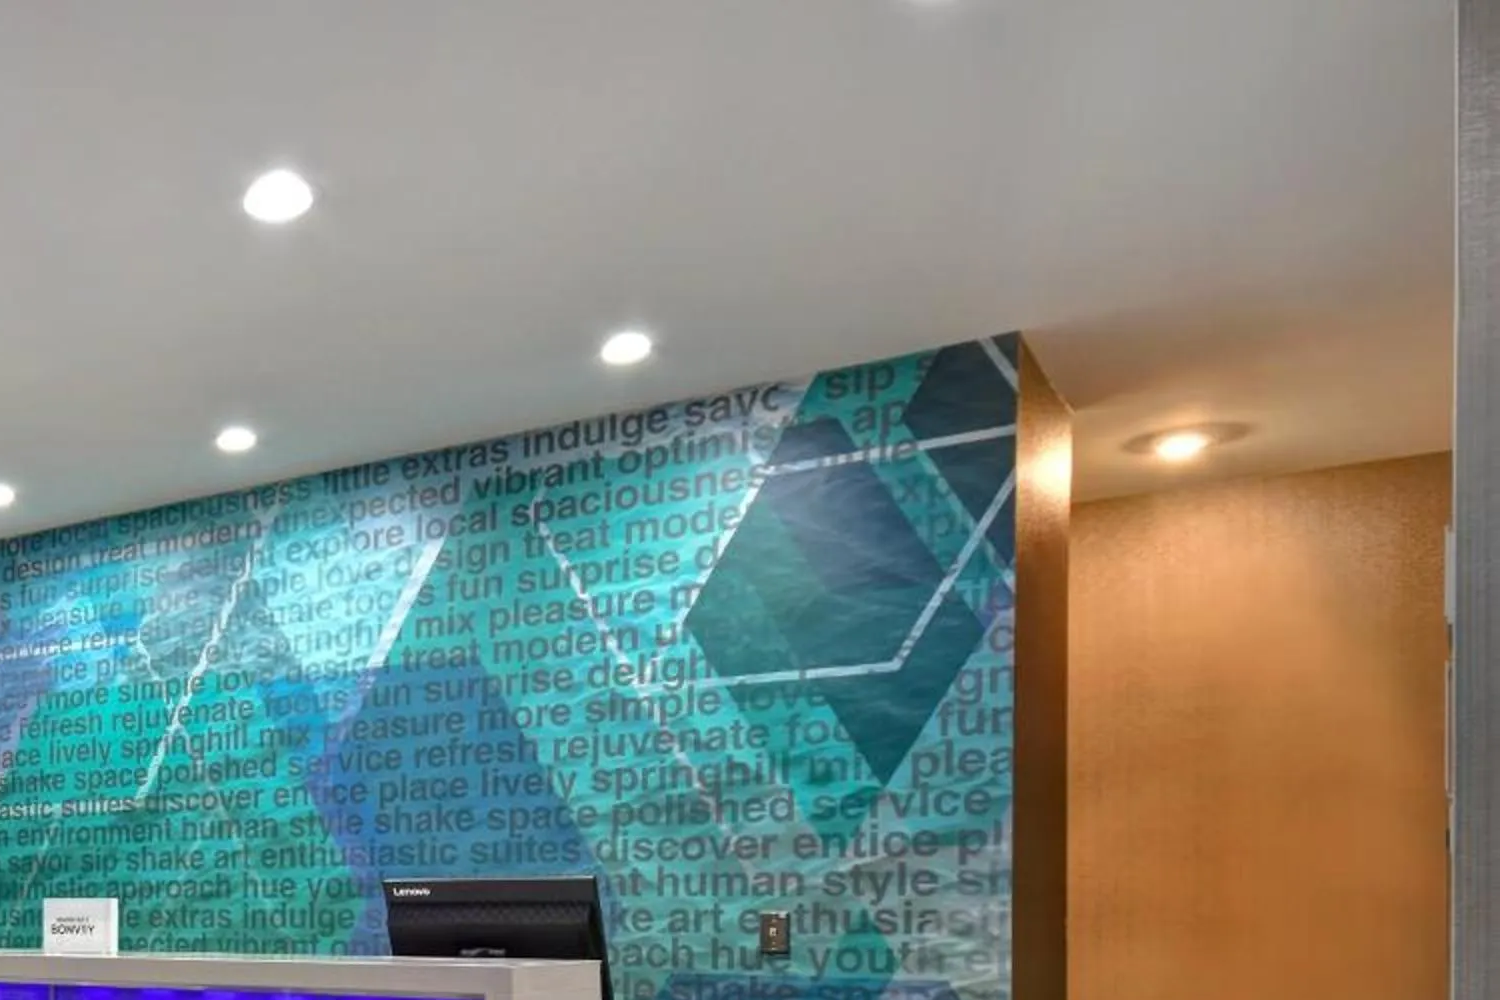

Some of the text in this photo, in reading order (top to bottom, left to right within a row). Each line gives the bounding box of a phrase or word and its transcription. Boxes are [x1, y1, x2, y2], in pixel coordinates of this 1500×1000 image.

[118, 480, 309, 538] spaciousness
[323, 464, 388, 495] little
[403, 441, 508, 481] extras
[524, 409, 668, 458] indulge
[685, 387, 778, 427] savo
[825, 364, 894, 401] sip
[3, 553, 79, 582] design
[92, 537, 146, 567] treat
[157, 519, 261, 556] modern
[275, 477, 459, 535] unexpected
[474, 452, 604, 500] vibrant
[619, 423, 777, 477] optimis
[20, 585, 56, 607] fun
[66, 566, 167, 599] surprise
[286, 525, 404, 564] explore
[417, 504, 496, 542] local
[511, 463, 767, 530] spaciousnes
[21, 600, 121, 637] pleasure
[134, 588, 198, 615] more
[318, 560, 383, 588] love
[395, 541, 510, 577] dsign
[523, 521, 609, 559] treat
[627, 503, 737, 544] mode
[345, 586, 433, 617] focs
[447, 576, 502, 603] fun
[517, 551, 678, 594] surprise
[416, 610, 474, 640] mix
[489, 590, 654, 638] pleasure
[20, 711, 101, 740] refresh
[113, 699, 253, 735] rejuvenate
[266, 691, 348, 718] focus
[423, 668, 572, 705] surprise
[588, 650, 706, 690] deligh
[48, 686, 108, 709] more
[118, 673, 204, 703] simple
[216, 668, 271, 692] love
[402, 641, 481, 673] treat
[493, 627, 637, 664] modern
[50, 739, 112, 766] lively
[121, 726, 246, 763] springhill
[260, 722, 310, 748] mix
[478, 704, 570, 731] more
[586, 687, 720, 725] simple
[74, 768, 147, 794] space
[159, 753, 276, 790] polished
[289, 747, 401, 776] service
[414, 735, 536, 768] refresh
[554, 722, 770, 765] rejuvenate
[789, 717, 850, 746] foc
[61, 794, 134, 817] suites
[145, 789, 261, 813] discover
[275, 780, 367, 806] entice
[380, 776, 468, 808] place
[481, 768, 575, 801] lively
[592, 755, 789, 798] springhill
[915, 746, 1012, 786] plea
[17, 821, 171, 847] environment
[182, 818, 277, 841] human
[289, 812, 363, 843] style
[375, 807, 475, 835] shake
[488, 807, 596, 838] space
[612, 793, 793, 835] polished
[811, 787, 992, 821] service
[8, 855, 71, 873] savor
[81, 850, 119, 877] sip
[127, 847, 203, 871] shake
[215, 847, 250, 869] art
[260, 840, 457, 868] enthusiastic
[470, 838, 580, 864] suites
[597, 834, 777, 862] discover
[794, 827, 938, 858] entice
[658, 869, 803, 896] human
[822, 864, 937, 902] style
[106, 875, 230, 904] approach
[244, 875, 295, 898] hue
[149, 907, 230, 928] extras
[245, 905, 354, 935] indulge
[393, 887, 432, 897] Lenovo
[668, 908, 722, 934] art
[219, 935, 318, 954] vibrant
[809, 943, 944, 979] youth
